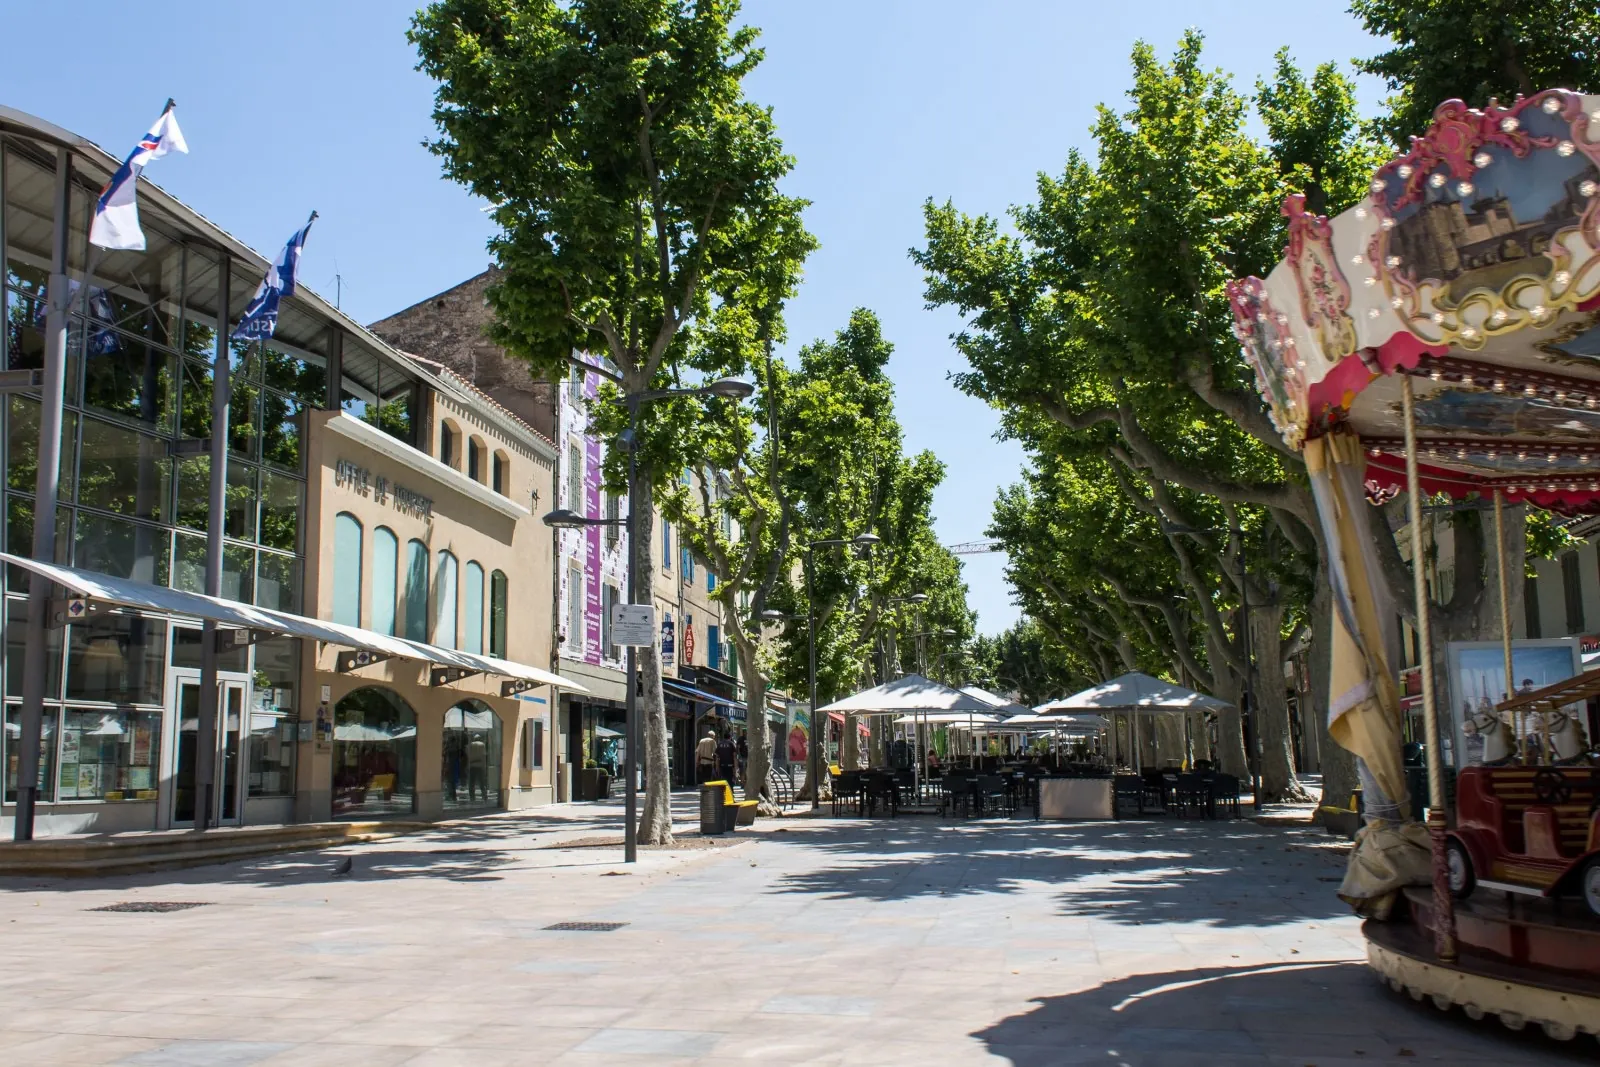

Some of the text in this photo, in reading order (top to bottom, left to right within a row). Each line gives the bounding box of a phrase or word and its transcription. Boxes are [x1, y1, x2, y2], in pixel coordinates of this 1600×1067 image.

[336, 459, 435, 525] OFFICE DE TOURISME
